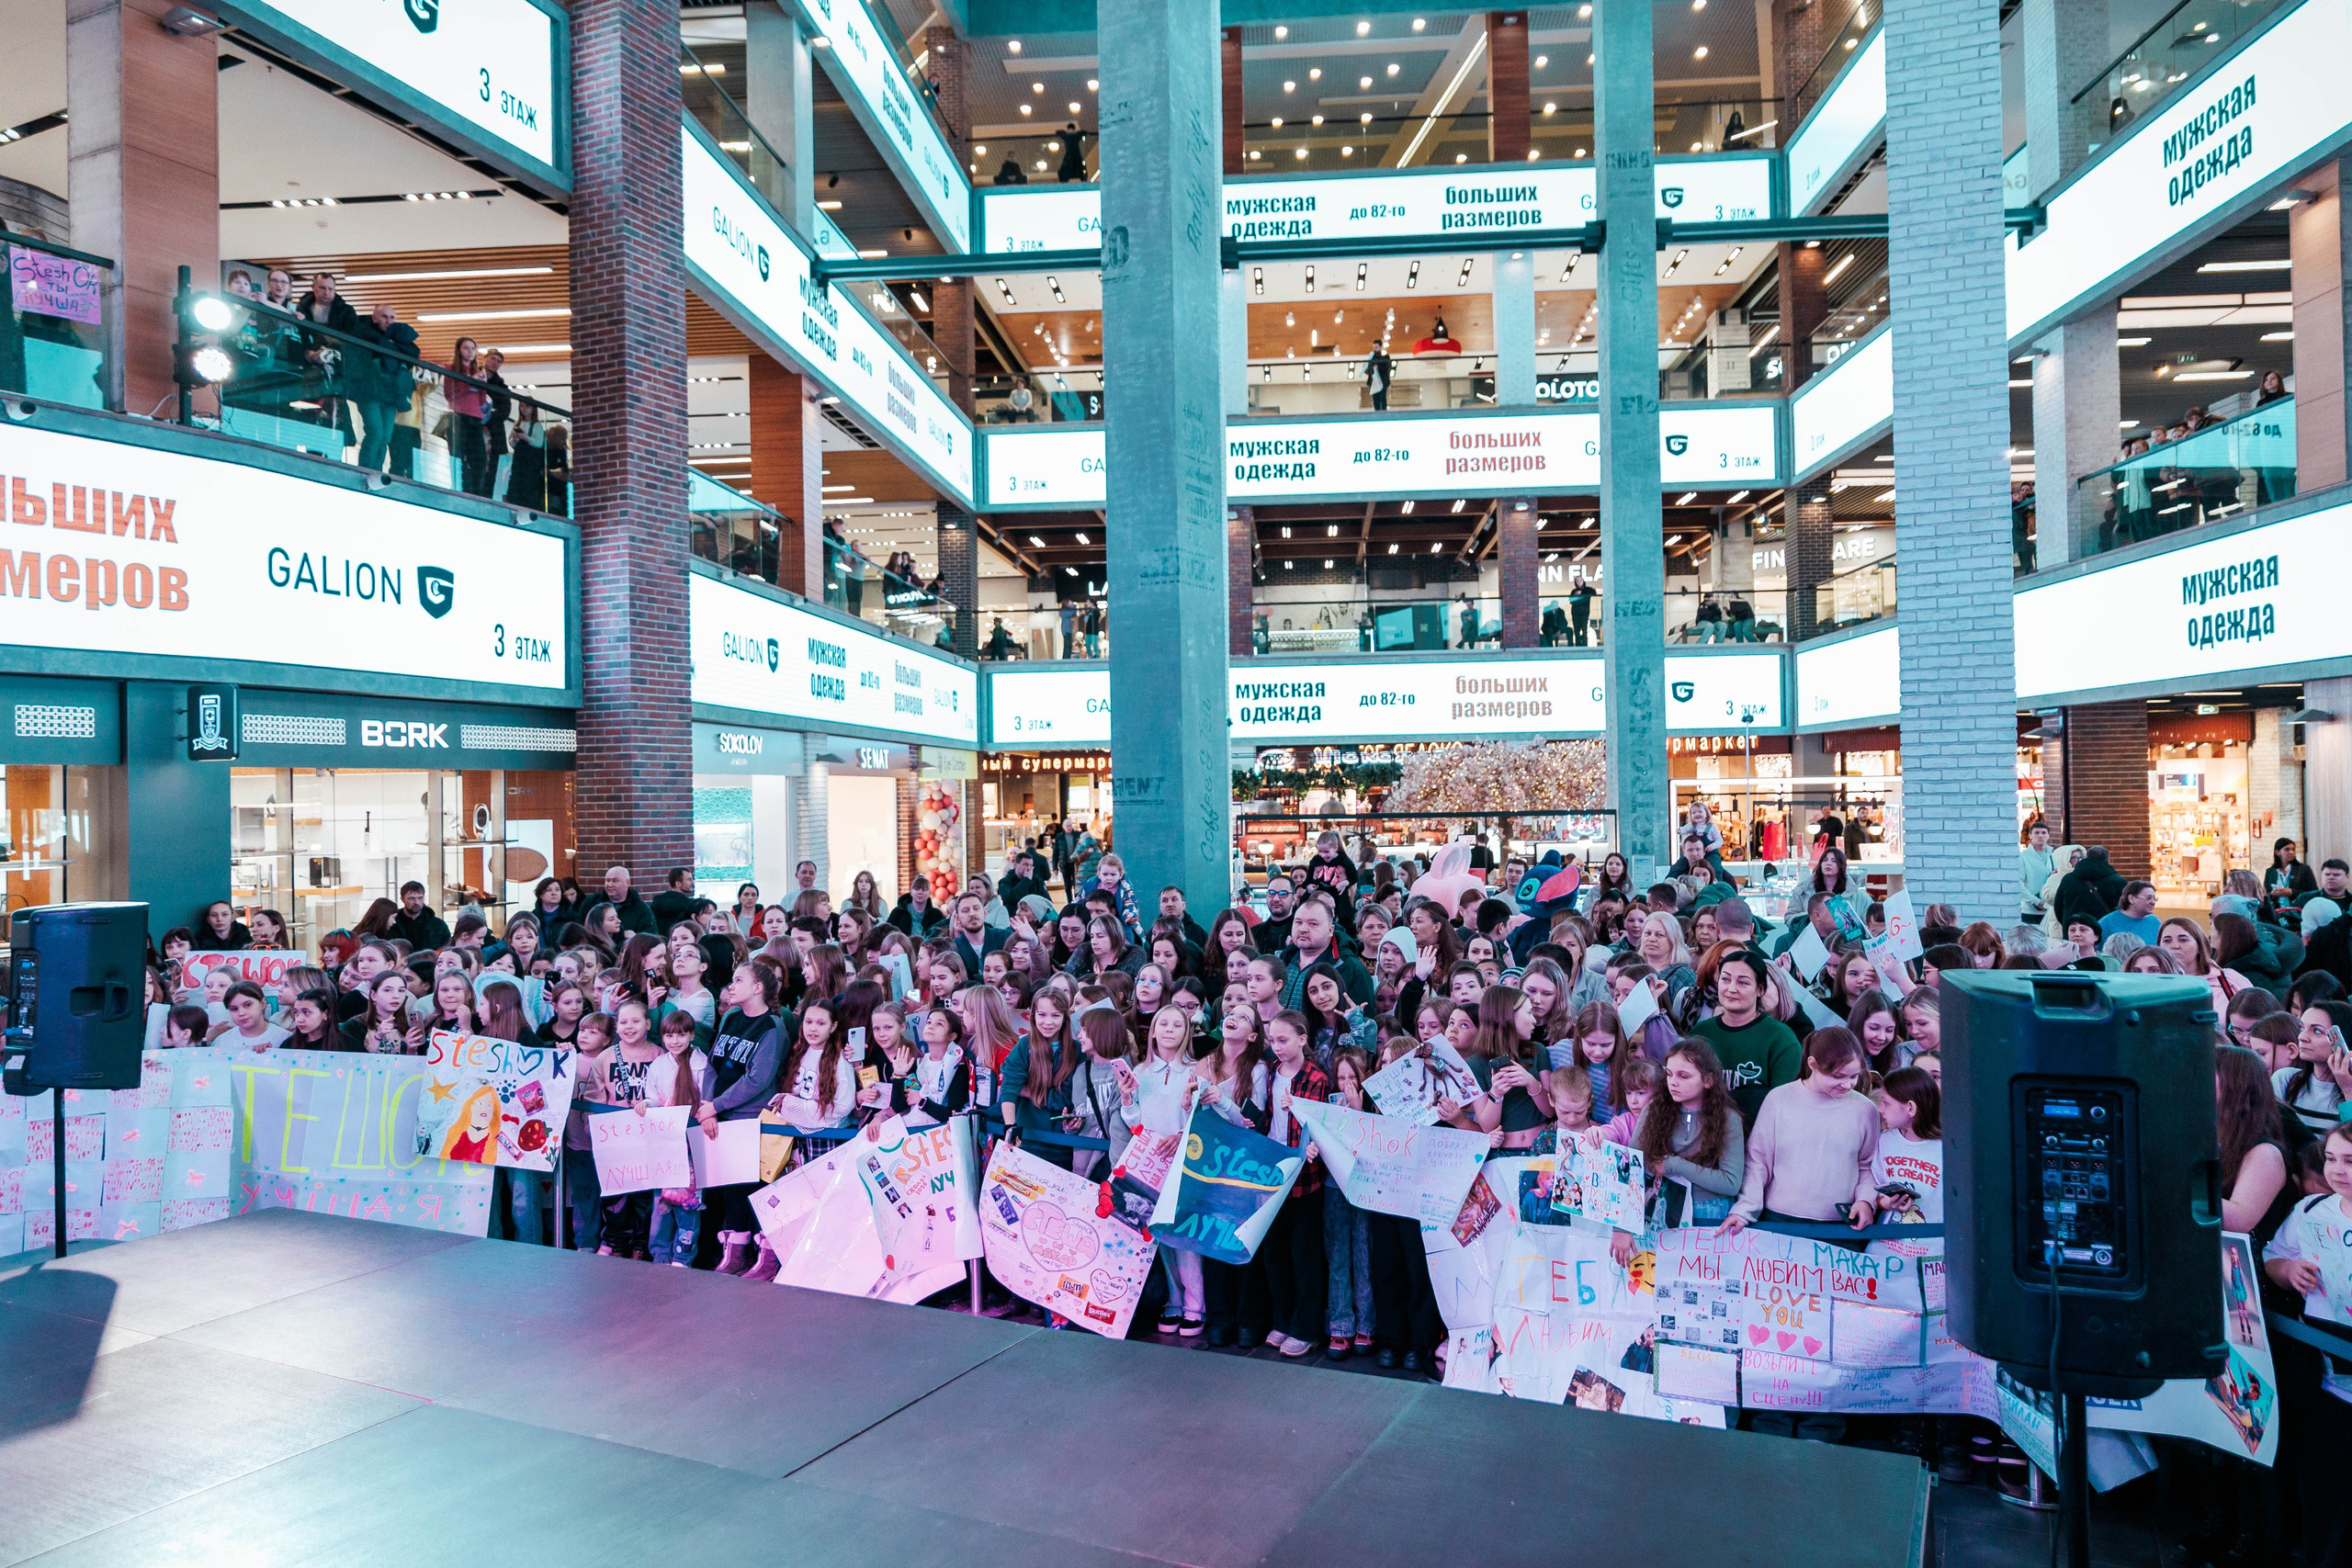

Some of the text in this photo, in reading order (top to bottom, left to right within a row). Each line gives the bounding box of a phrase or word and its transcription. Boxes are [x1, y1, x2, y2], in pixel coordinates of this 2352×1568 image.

[480, 68, 490, 103] 3
[2163, 75, 2256, 169] мужская
[2168, 125, 2253, 207] одежда
[1226, 194, 1316, 216] мужская
[1445, 184, 1538, 206] больших
[1350, 204, 1406, 221] до 82-го
[1442, 209, 1543, 231] размеров
[1714, 205, 1724, 220] 3
[713, 207, 755, 267] GALION
[1231, 218, 1313, 238] одежда
[799, 274, 839, 332] мужская
[802, 310, 837, 362] одежда
[1230, 437, 1320, 458] мужская
[1449, 431, 1543, 450] больших
[1353, 447, 1410, 464] до 82-го
[1445, 454, 1546, 475] размеров
[1719, 454, 1727, 468] 3
[1234, 462, 1316, 481] одежда
[1009, 476, 1016, 491] 3
[268, 547, 401, 605] GALION
[2182, 553, 2279, 606] мужская
[2188, 603, 2275, 651] одежда
[494, 624, 504, 658] 3
[723, 631, 763, 666] GALION
[808, 637, 846, 670] мужская
[894, 660, 922, 688] больших
[1455, 674, 1549, 695] больших
[810, 671, 845, 702] одежда
[1235, 681, 1326, 702] мужская
[894, 692, 922, 716] размеров
[1360, 691, 1416, 707] до 82-го
[1452, 698, 1553, 720] размеров
[1725, 700, 1734, 716] 3
[1014, 716, 1022, 731] 3
[1240, 704, 1322, 724] одежда
[361, 719, 448, 749] BORK
[719, 732, 763, 754] SOKOLOV
[860, 747, 889, 770] SENAT
[1897, 1167, 1939, 1189] CREATE
[1679, 1255, 1878, 1301] МЫ ЛЮБИМ ВАС!
[1756, 1286, 1821, 1313] LOVE
[1761, 1303, 1804, 1329] YOU
[1743, 1348, 1819, 1377] ВОЗЬМИТЕ
[1772, 1377, 1789, 1392] НА
